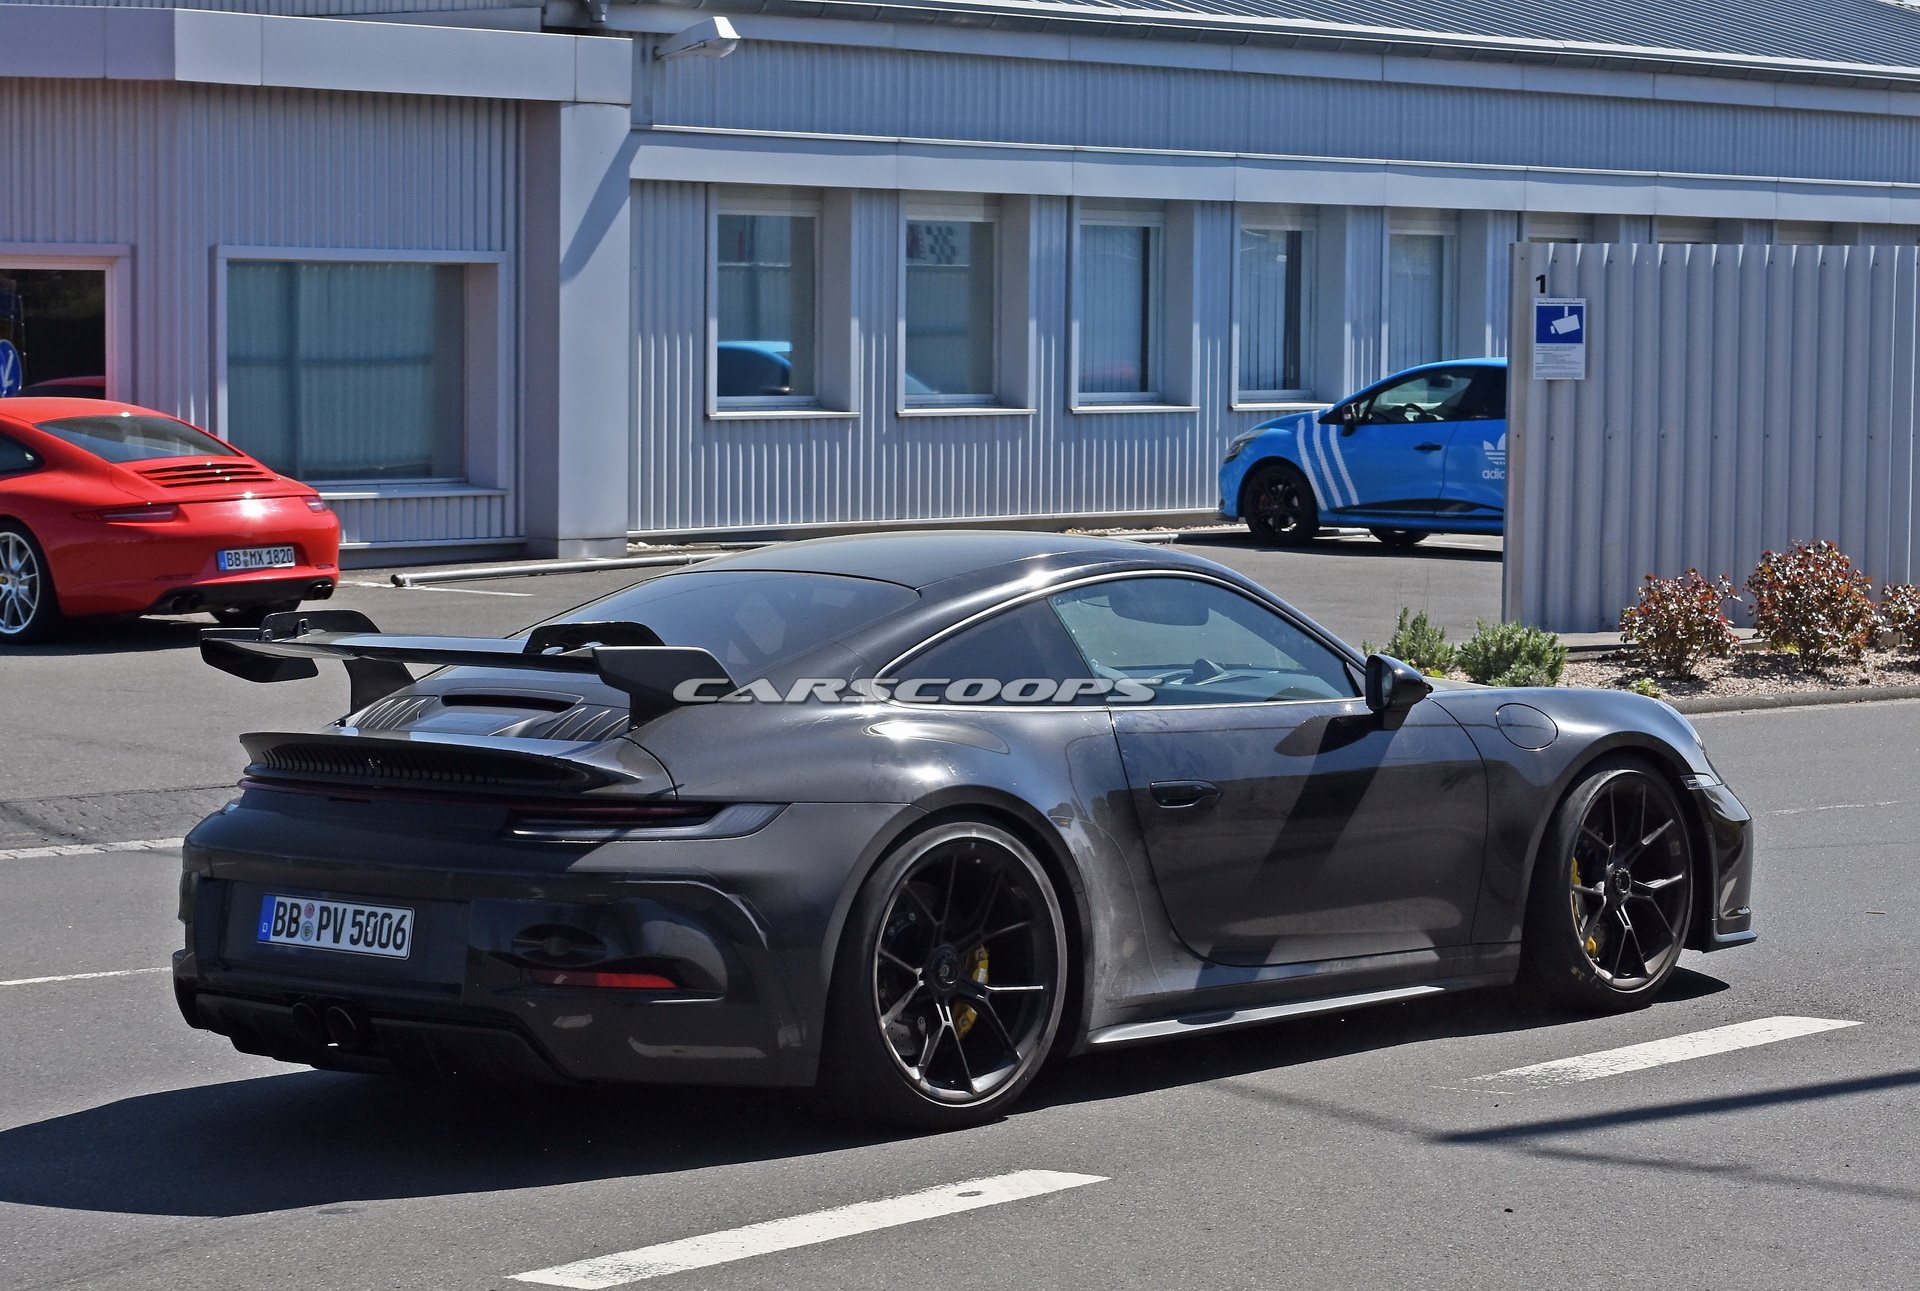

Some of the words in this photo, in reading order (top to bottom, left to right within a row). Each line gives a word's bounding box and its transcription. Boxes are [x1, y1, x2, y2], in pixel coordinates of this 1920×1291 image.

[1536, 274, 1546, 294] 1
[226, 552, 241, 567] BB
[249, 550, 264, 566] MX
[266, 548, 293, 565] 1820
[272, 901, 301, 938] BB
[316, 905, 347, 944] PV
[349, 909, 407, 950] 5006
